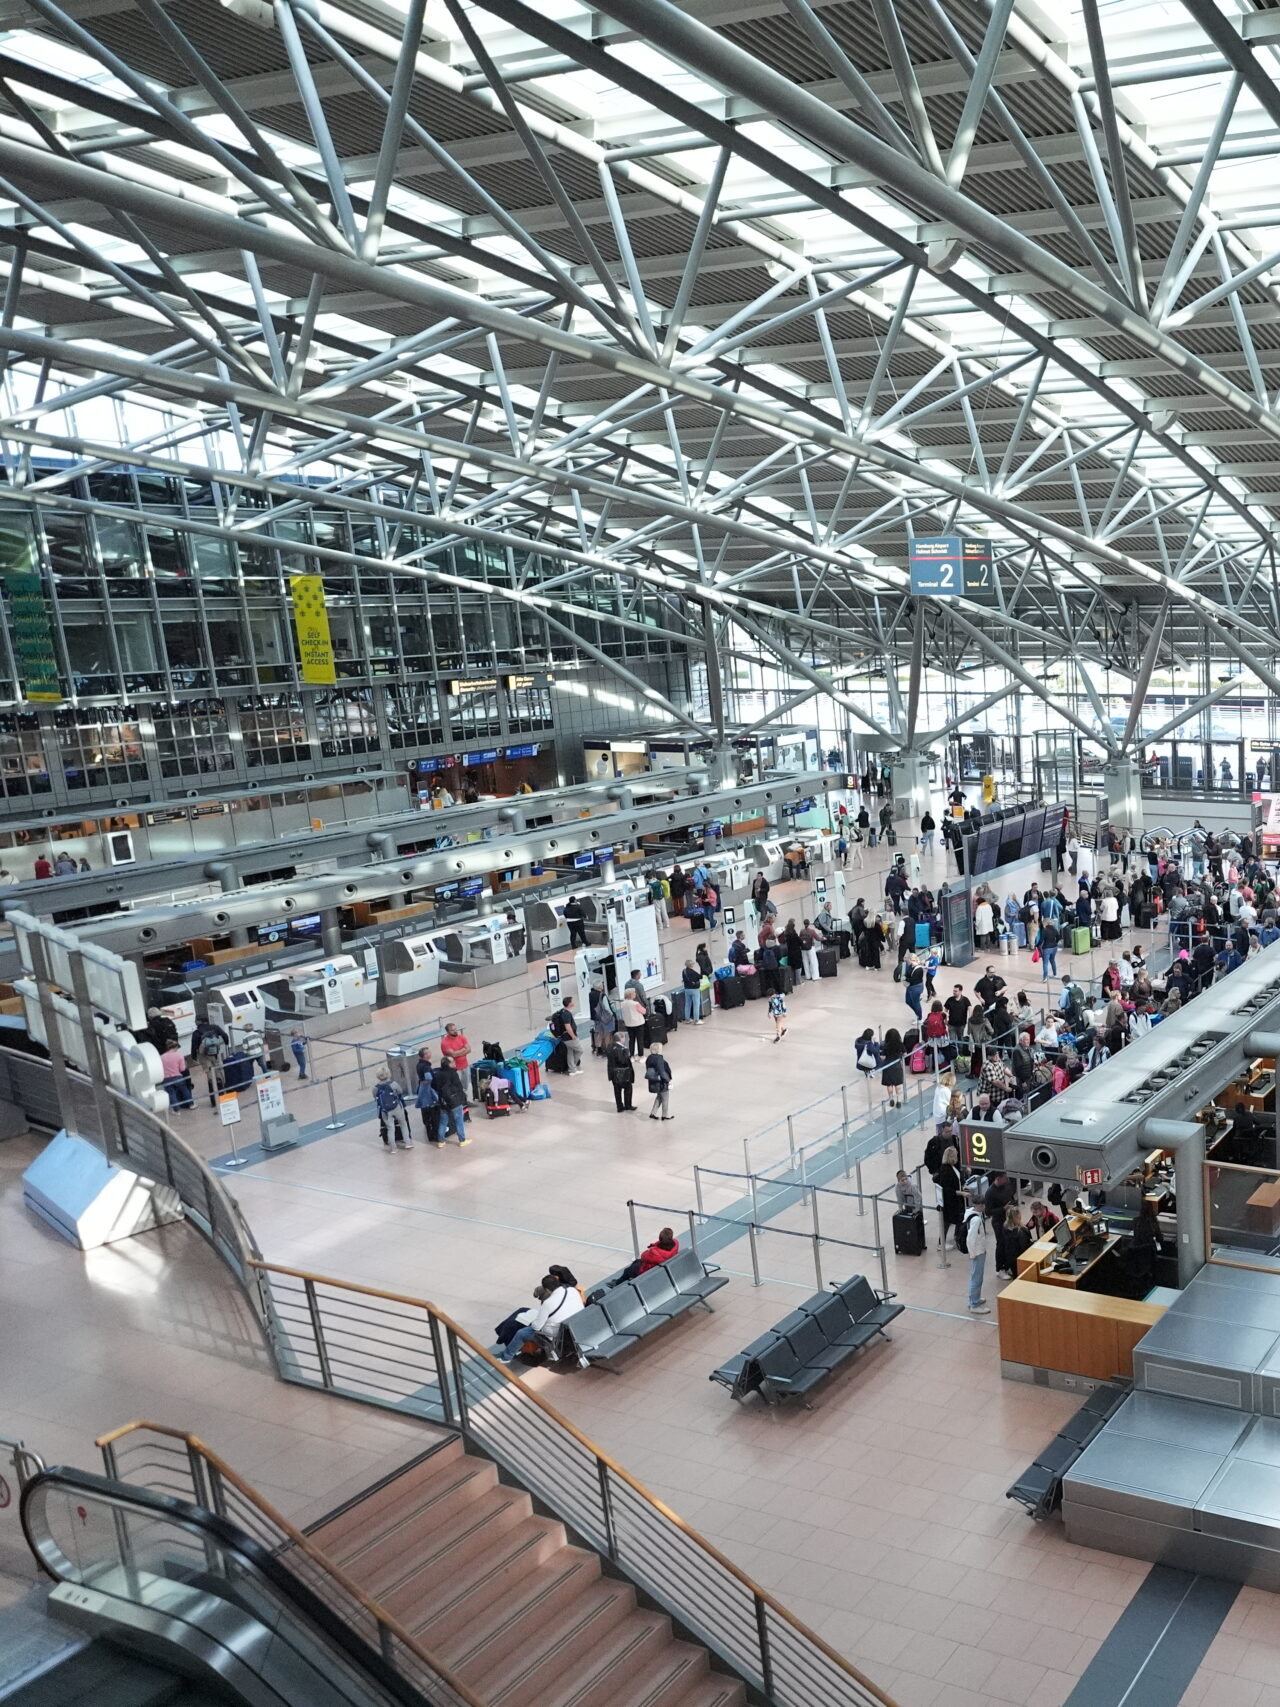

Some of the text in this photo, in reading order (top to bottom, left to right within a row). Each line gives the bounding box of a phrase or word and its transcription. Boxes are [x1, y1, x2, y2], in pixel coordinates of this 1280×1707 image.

[940, 564, 954, 587] 2
[980, 564, 988, 587] 2
[847, 776, 854, 785] 8
[972, 1132, 987, 1156] 9
